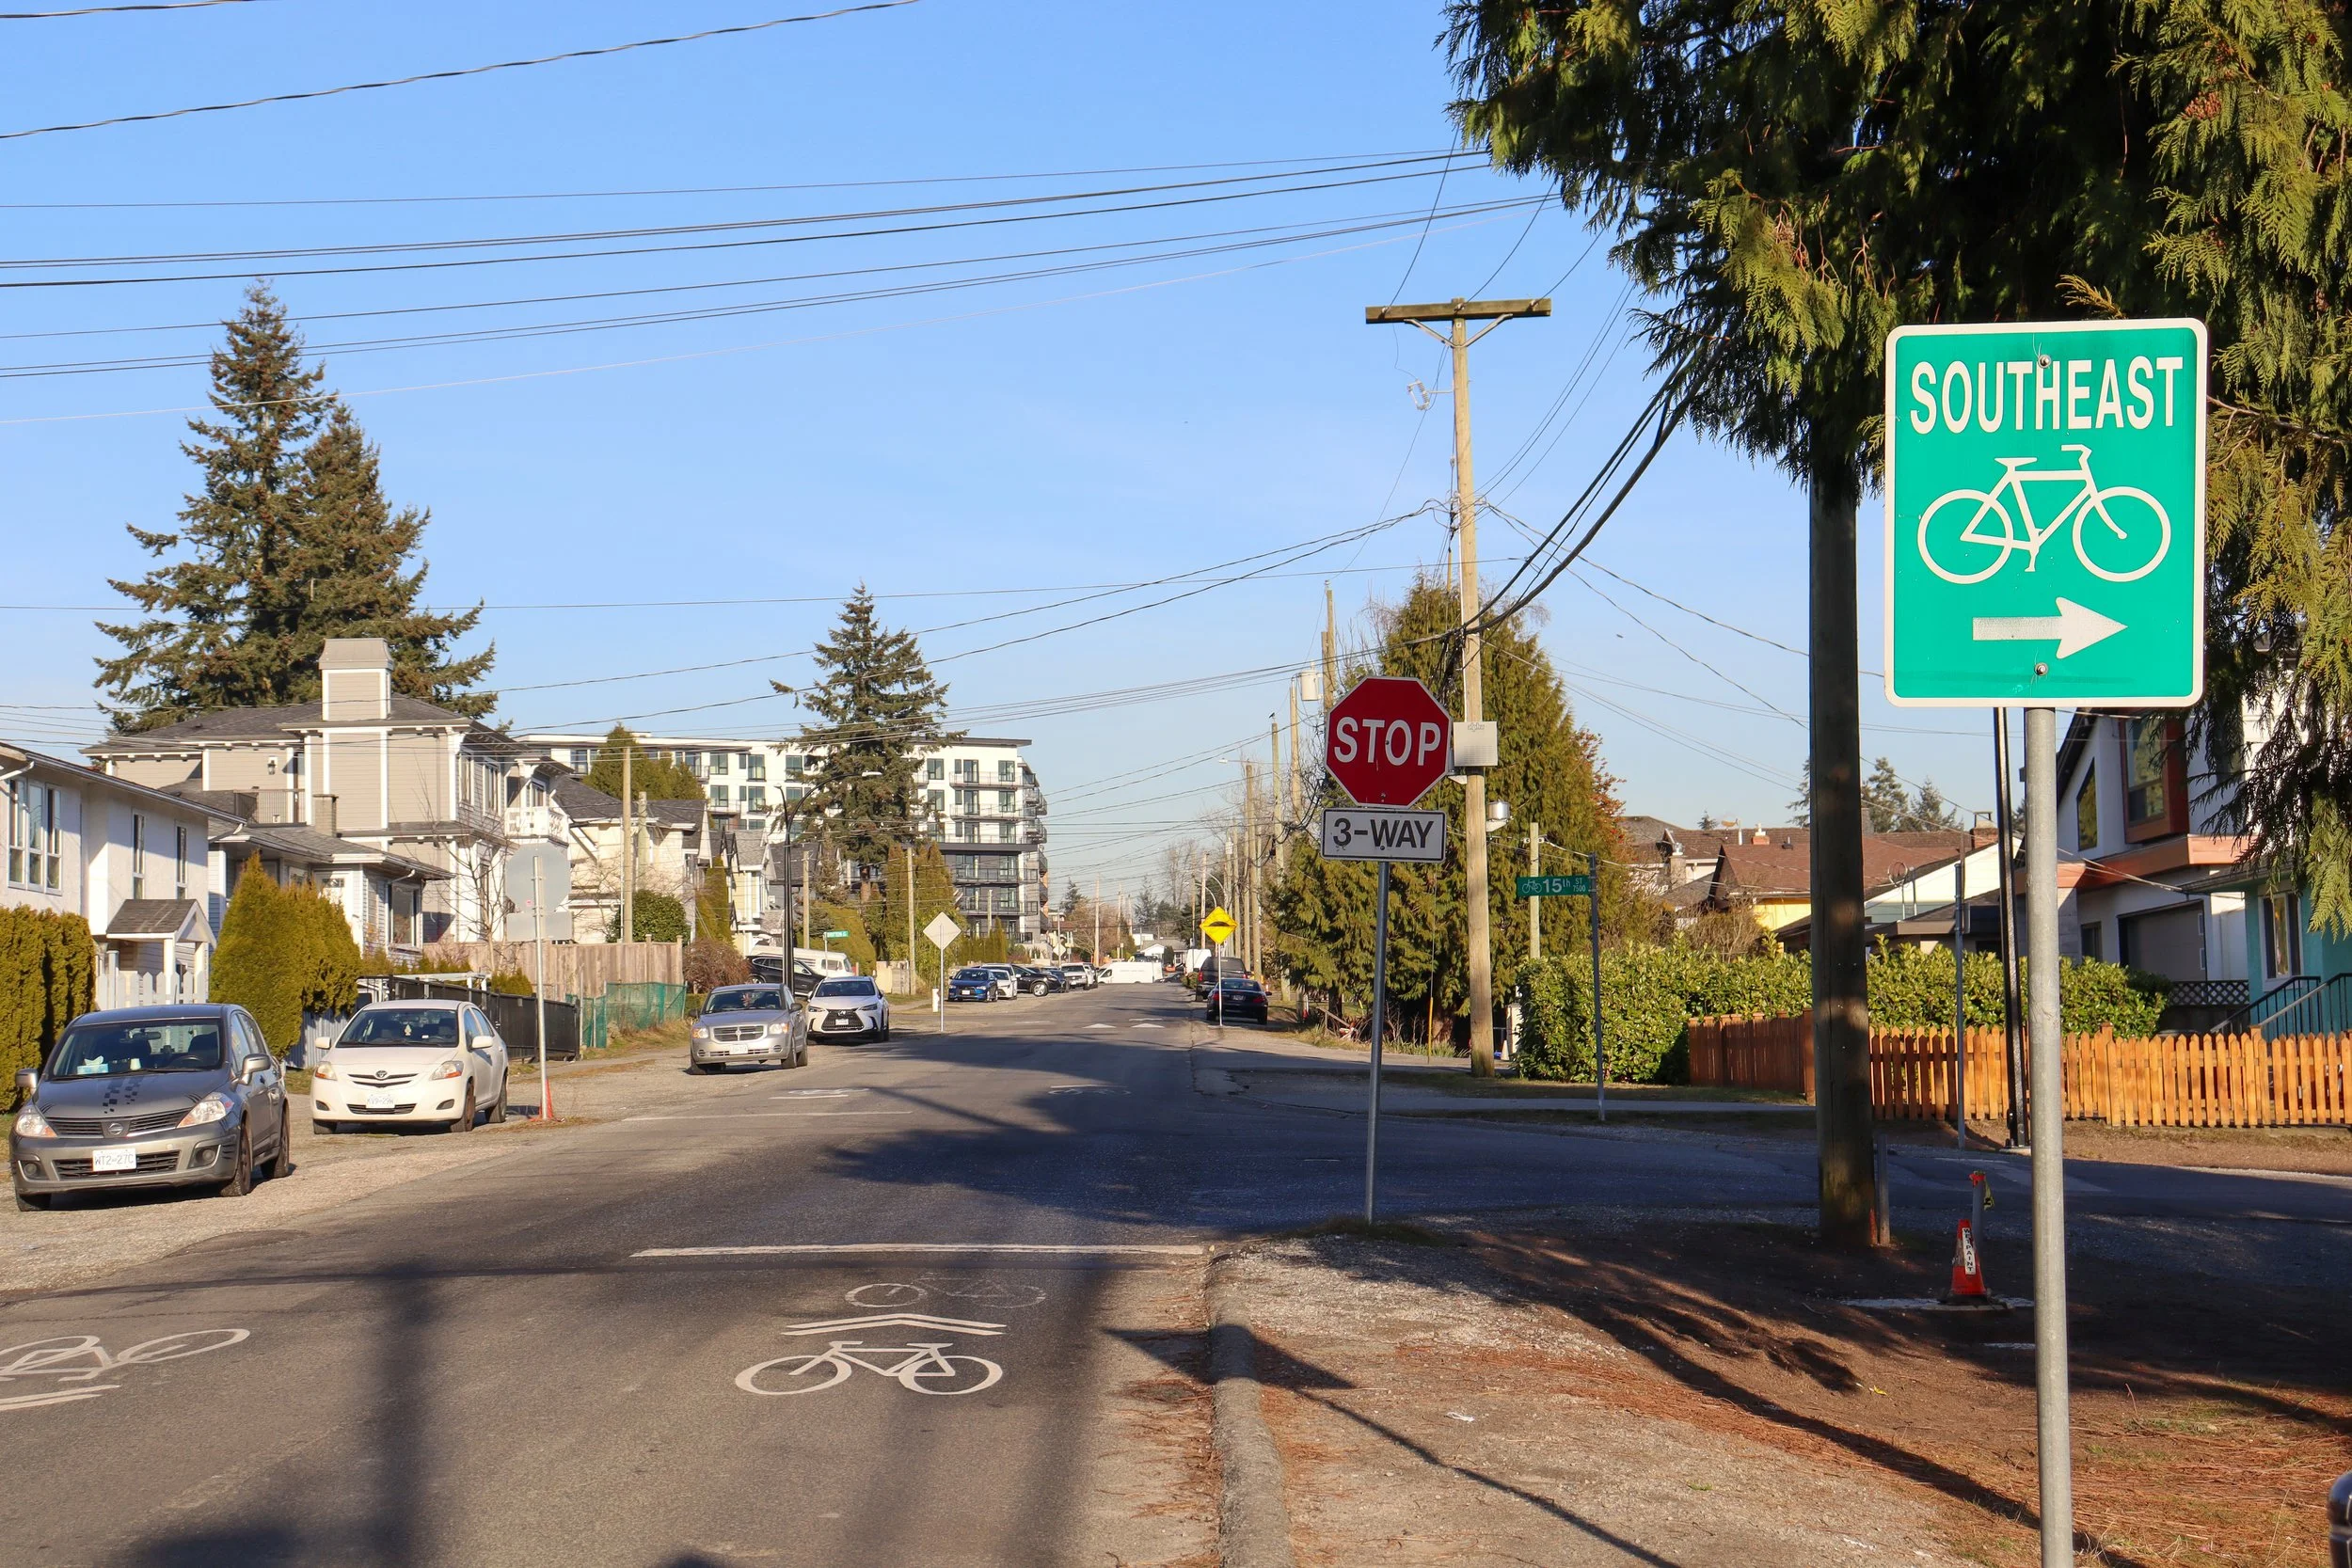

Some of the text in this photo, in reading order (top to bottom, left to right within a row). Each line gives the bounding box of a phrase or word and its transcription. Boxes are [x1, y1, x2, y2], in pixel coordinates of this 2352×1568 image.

[1910, 356, 2184, 435] SOUTHEAST
[1335, 718, 1441, 766] STOP
[1333, 817, 1435, 848] 3-WAY
[1542, 877, 1583, 894] 15th ST
[1965, 1244, 1975, 1272] PAINT
